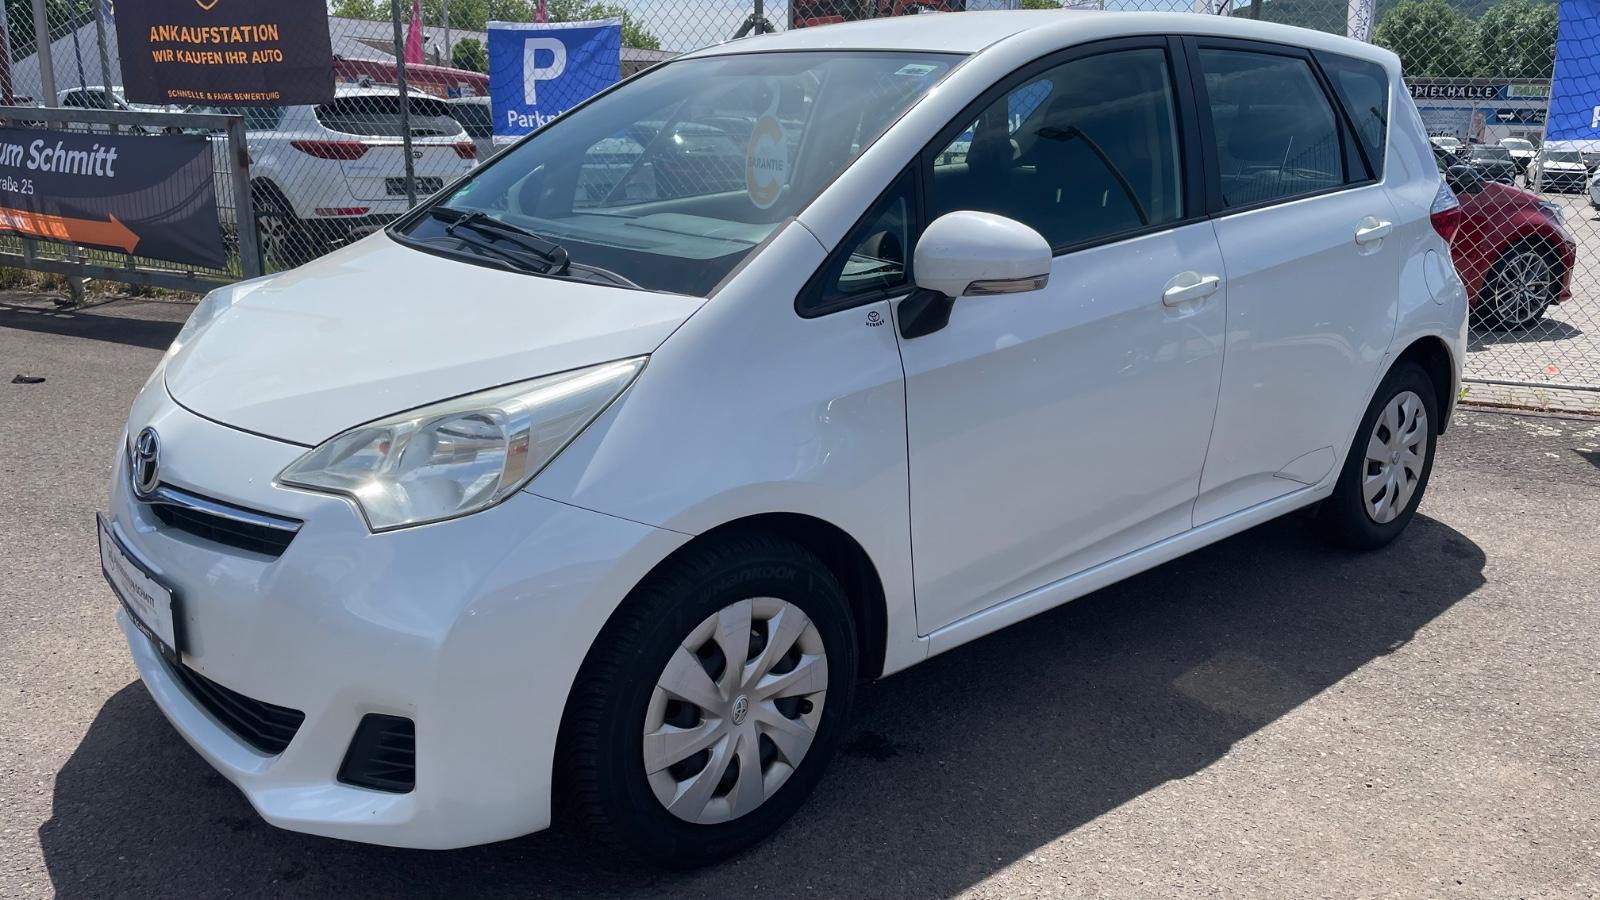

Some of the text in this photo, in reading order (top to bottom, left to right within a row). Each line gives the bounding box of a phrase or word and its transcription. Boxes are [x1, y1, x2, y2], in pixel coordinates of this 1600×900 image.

[150, 24, 279, 43] ANKAUFSTATION
[152, 49, 283, 64] WIR KAUFEN IHR AUTO
[523, 37, 567, 105] P
[167, 89, 280, 100] SCHNELLE & FAIRE BEWERTUNG
[1407, 86, 1492, 98] SPIELHALLE
[26, 139, 118, 177] Schmitt
[21, 178, 34, 195] 25
